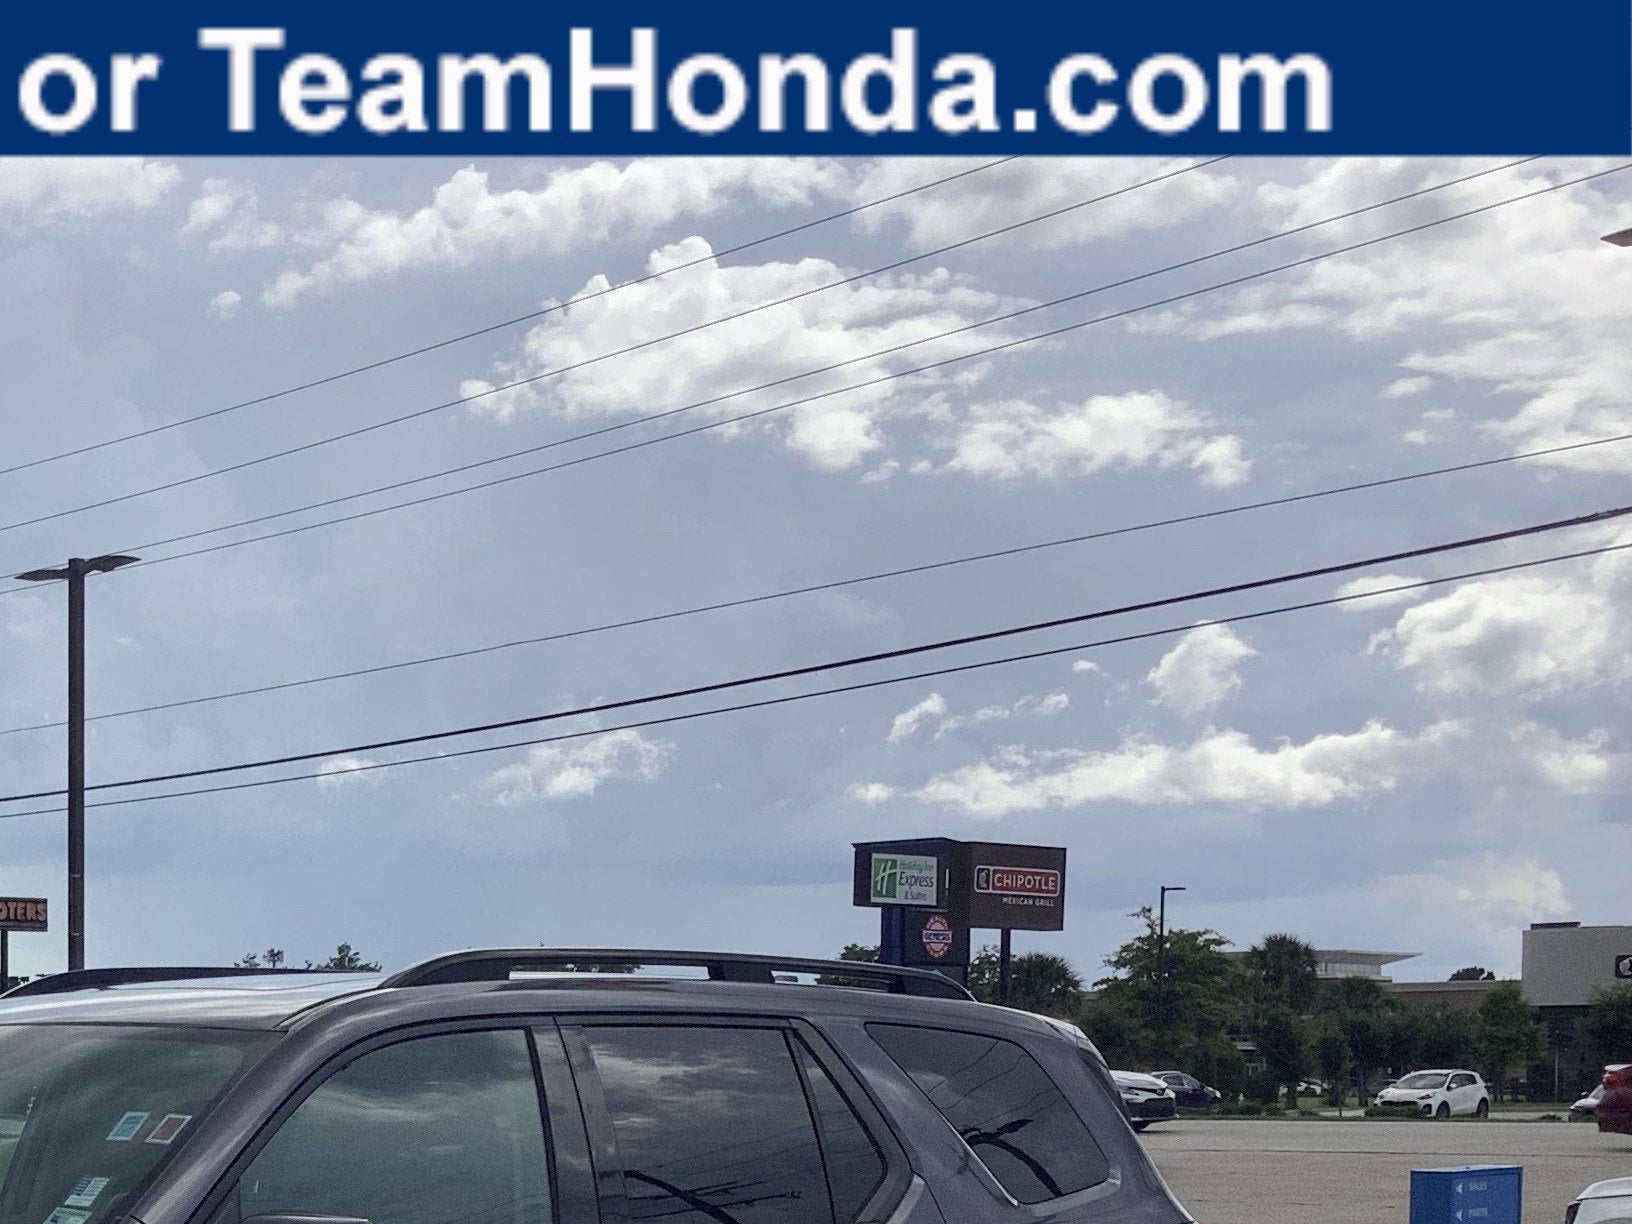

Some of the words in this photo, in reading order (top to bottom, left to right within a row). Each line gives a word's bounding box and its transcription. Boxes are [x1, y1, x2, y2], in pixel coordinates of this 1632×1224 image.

[898, 871, 934, 889] Express
[994, 873, 1056, 890] CHIPOTLE
[1002, 896, 1033, 906] MEXICAN
[1035, 898, 1054, 907] GRILL
